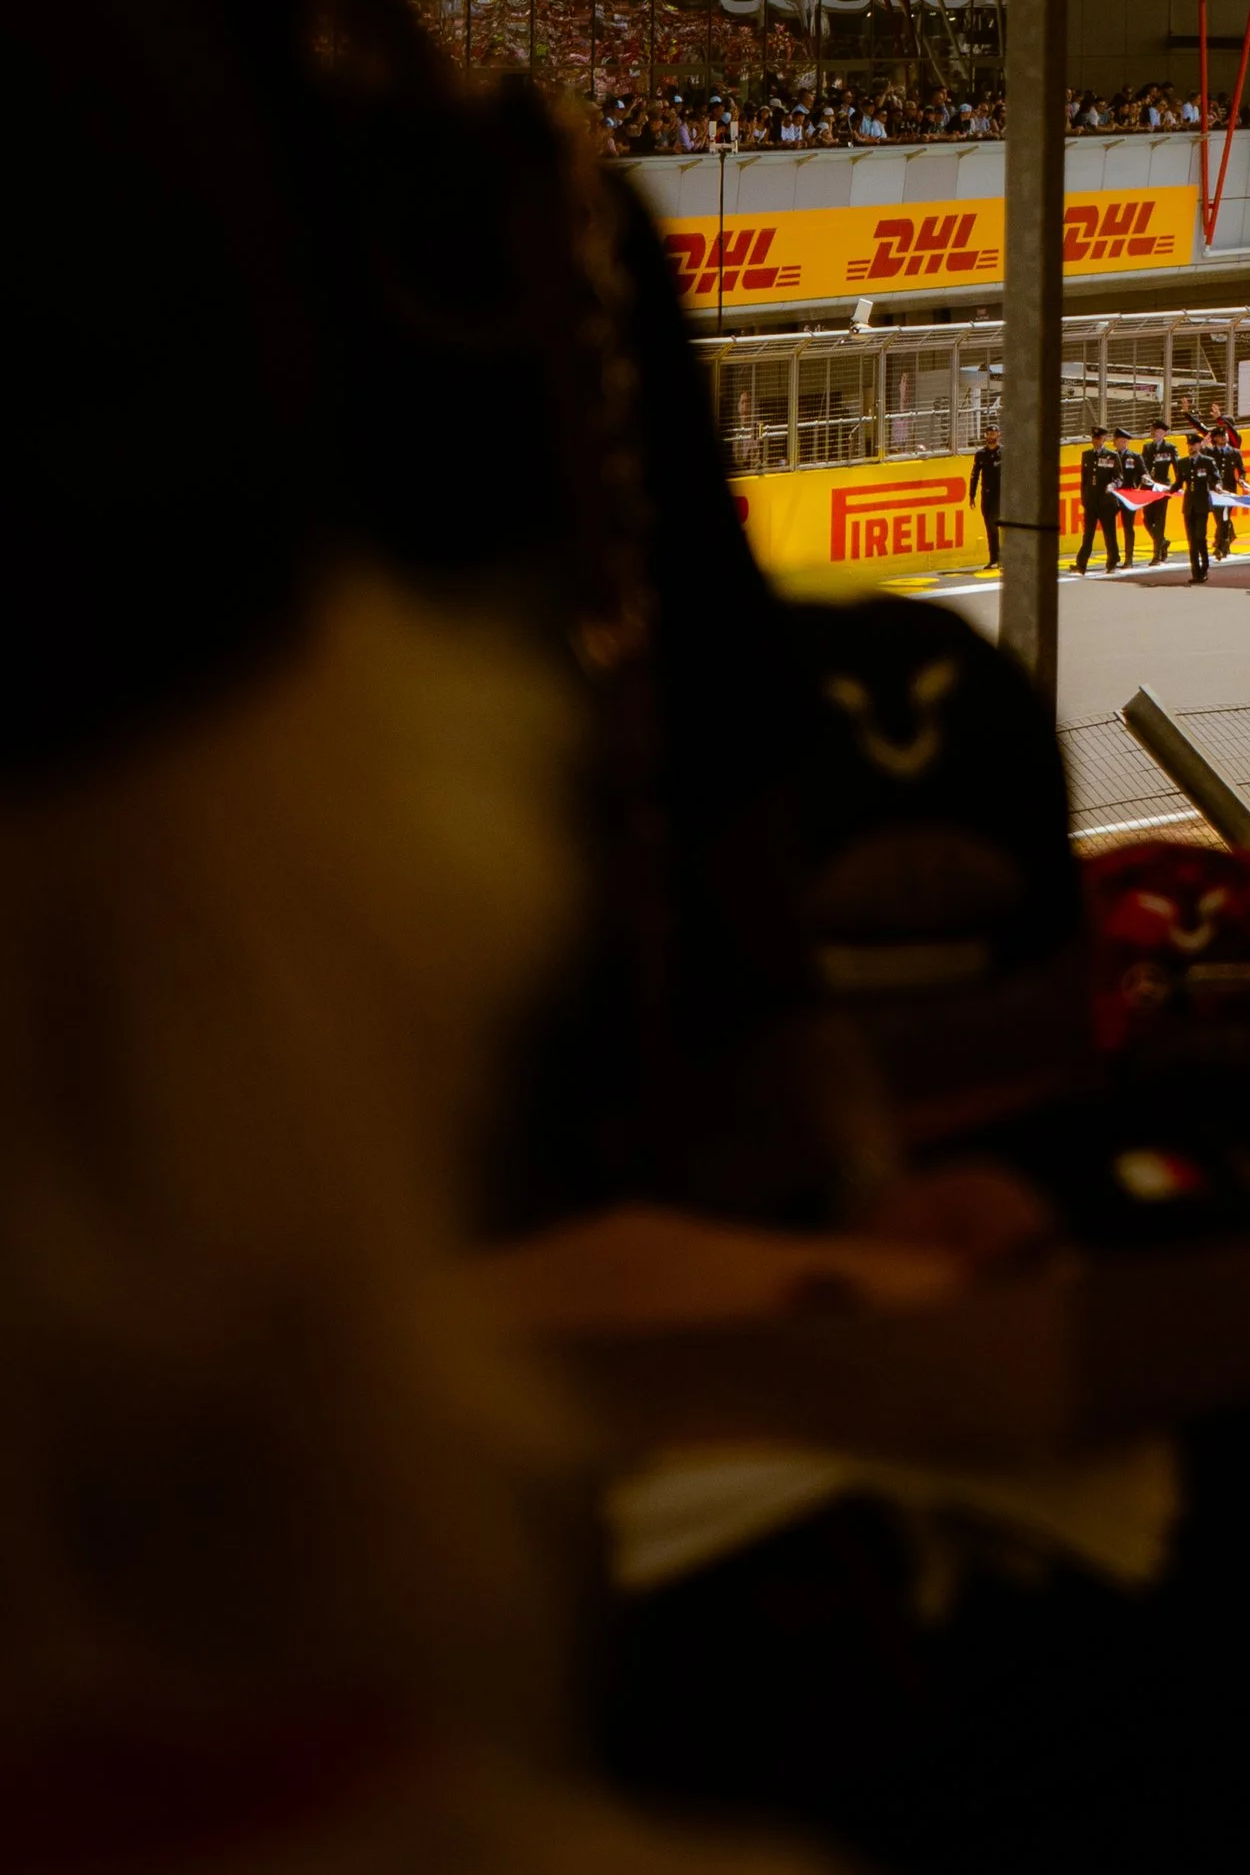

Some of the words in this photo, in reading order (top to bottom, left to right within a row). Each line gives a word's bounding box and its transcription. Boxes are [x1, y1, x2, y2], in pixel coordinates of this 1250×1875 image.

[661, 227, 777, 297] DHL
[866, 213, 978, 281] DHL
[1063, 201, 1157, 262] DHL
[830, 476, 967, 562] PIRELLI
